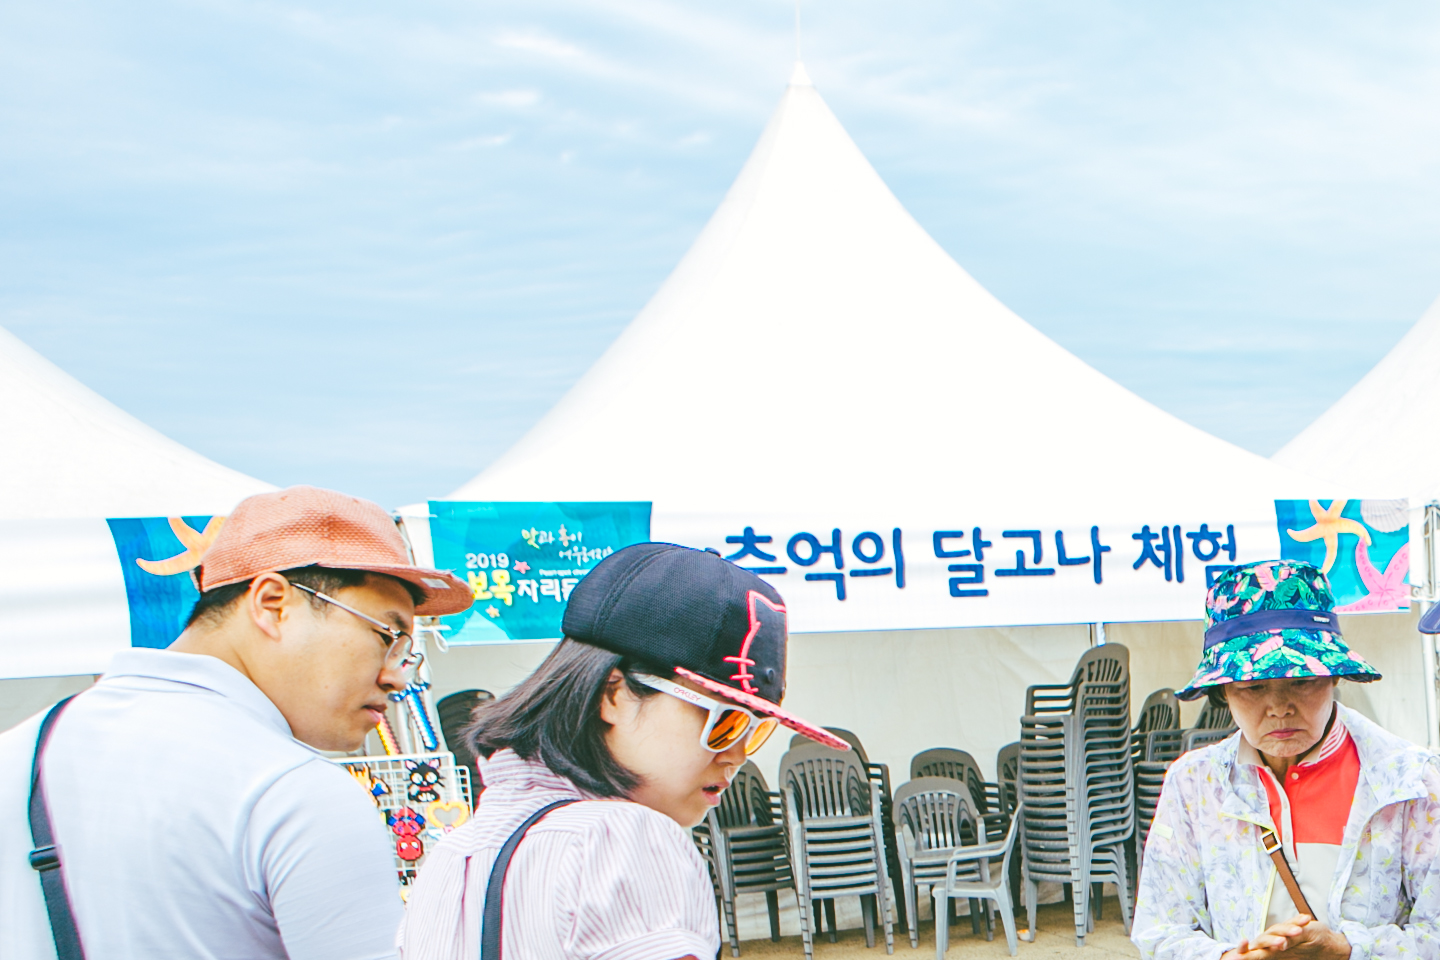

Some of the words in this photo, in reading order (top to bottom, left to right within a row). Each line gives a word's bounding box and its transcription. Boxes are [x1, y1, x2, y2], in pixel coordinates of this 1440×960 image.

[521, 526, 555, 550] 맛과
[558, 523, 582, 547] 흥이
[465, 552, 509, 569] 2019
[725, 526, 906, 601] 추억의
[932, 526, 1111, 598] 달고나
[1131, 523, 1237, 588] 체험
[466, 569, 516, 607] 보목
[673, 686, 701, 702] OAKLEY
